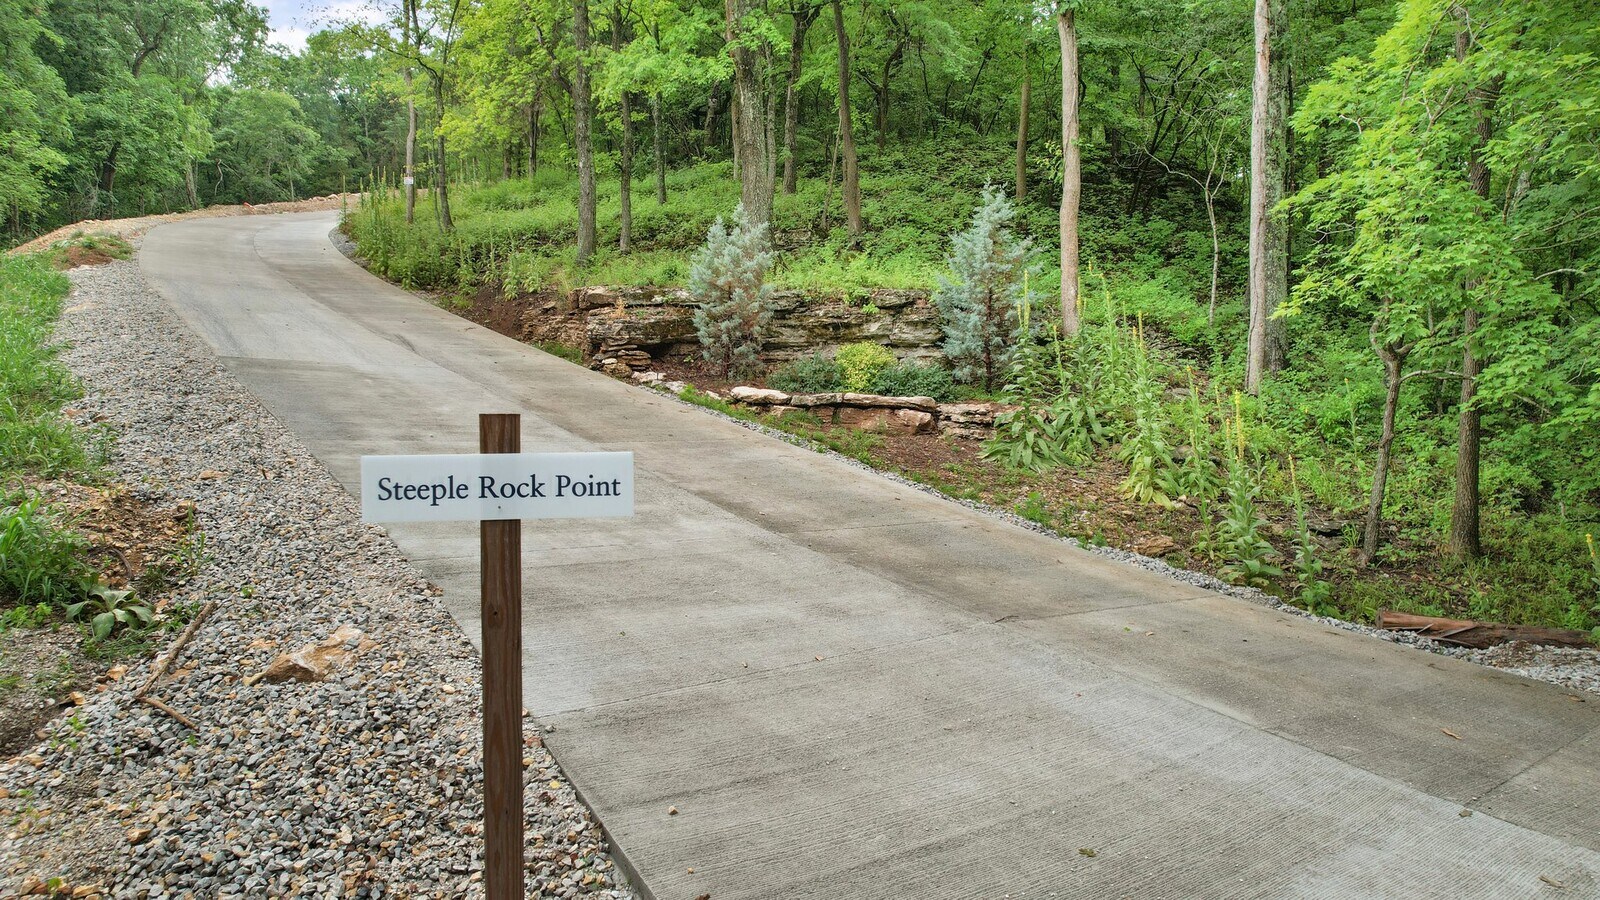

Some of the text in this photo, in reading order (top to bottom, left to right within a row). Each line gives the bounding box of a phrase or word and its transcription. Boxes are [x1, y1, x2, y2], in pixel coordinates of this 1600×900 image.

[377, 474, 621, 506] Steeple Rock Point
